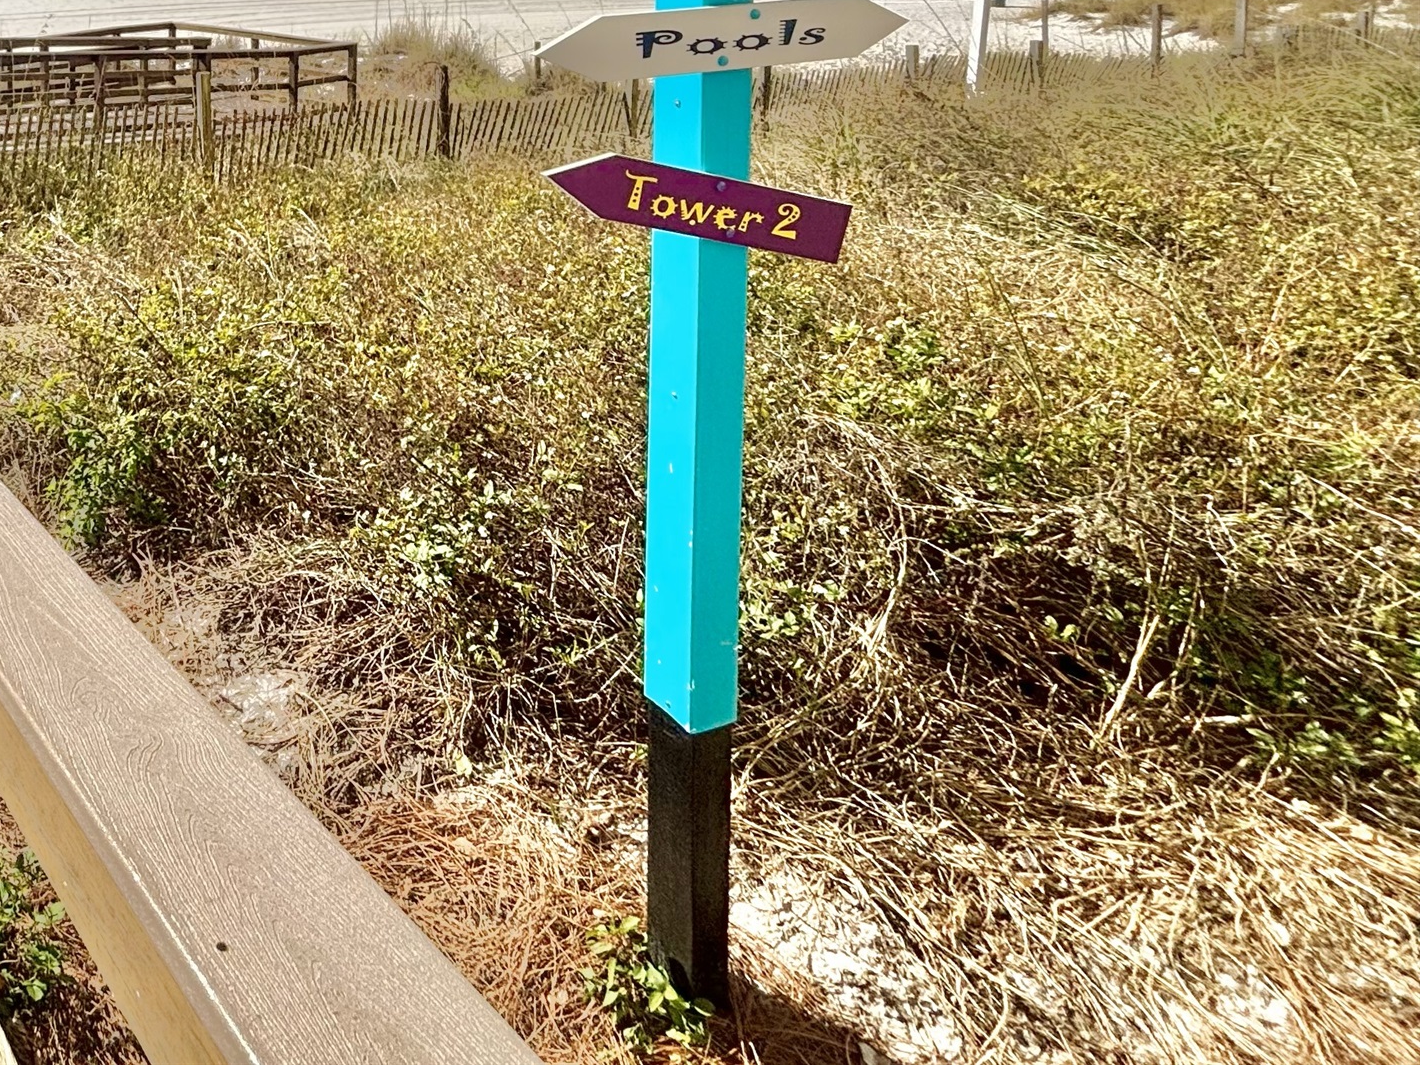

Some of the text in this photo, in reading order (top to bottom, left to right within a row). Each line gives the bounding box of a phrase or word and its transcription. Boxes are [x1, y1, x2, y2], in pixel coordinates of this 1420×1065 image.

[635, 18, 826, 59] Pools
[625, 169, 801, 240] Tower 2
